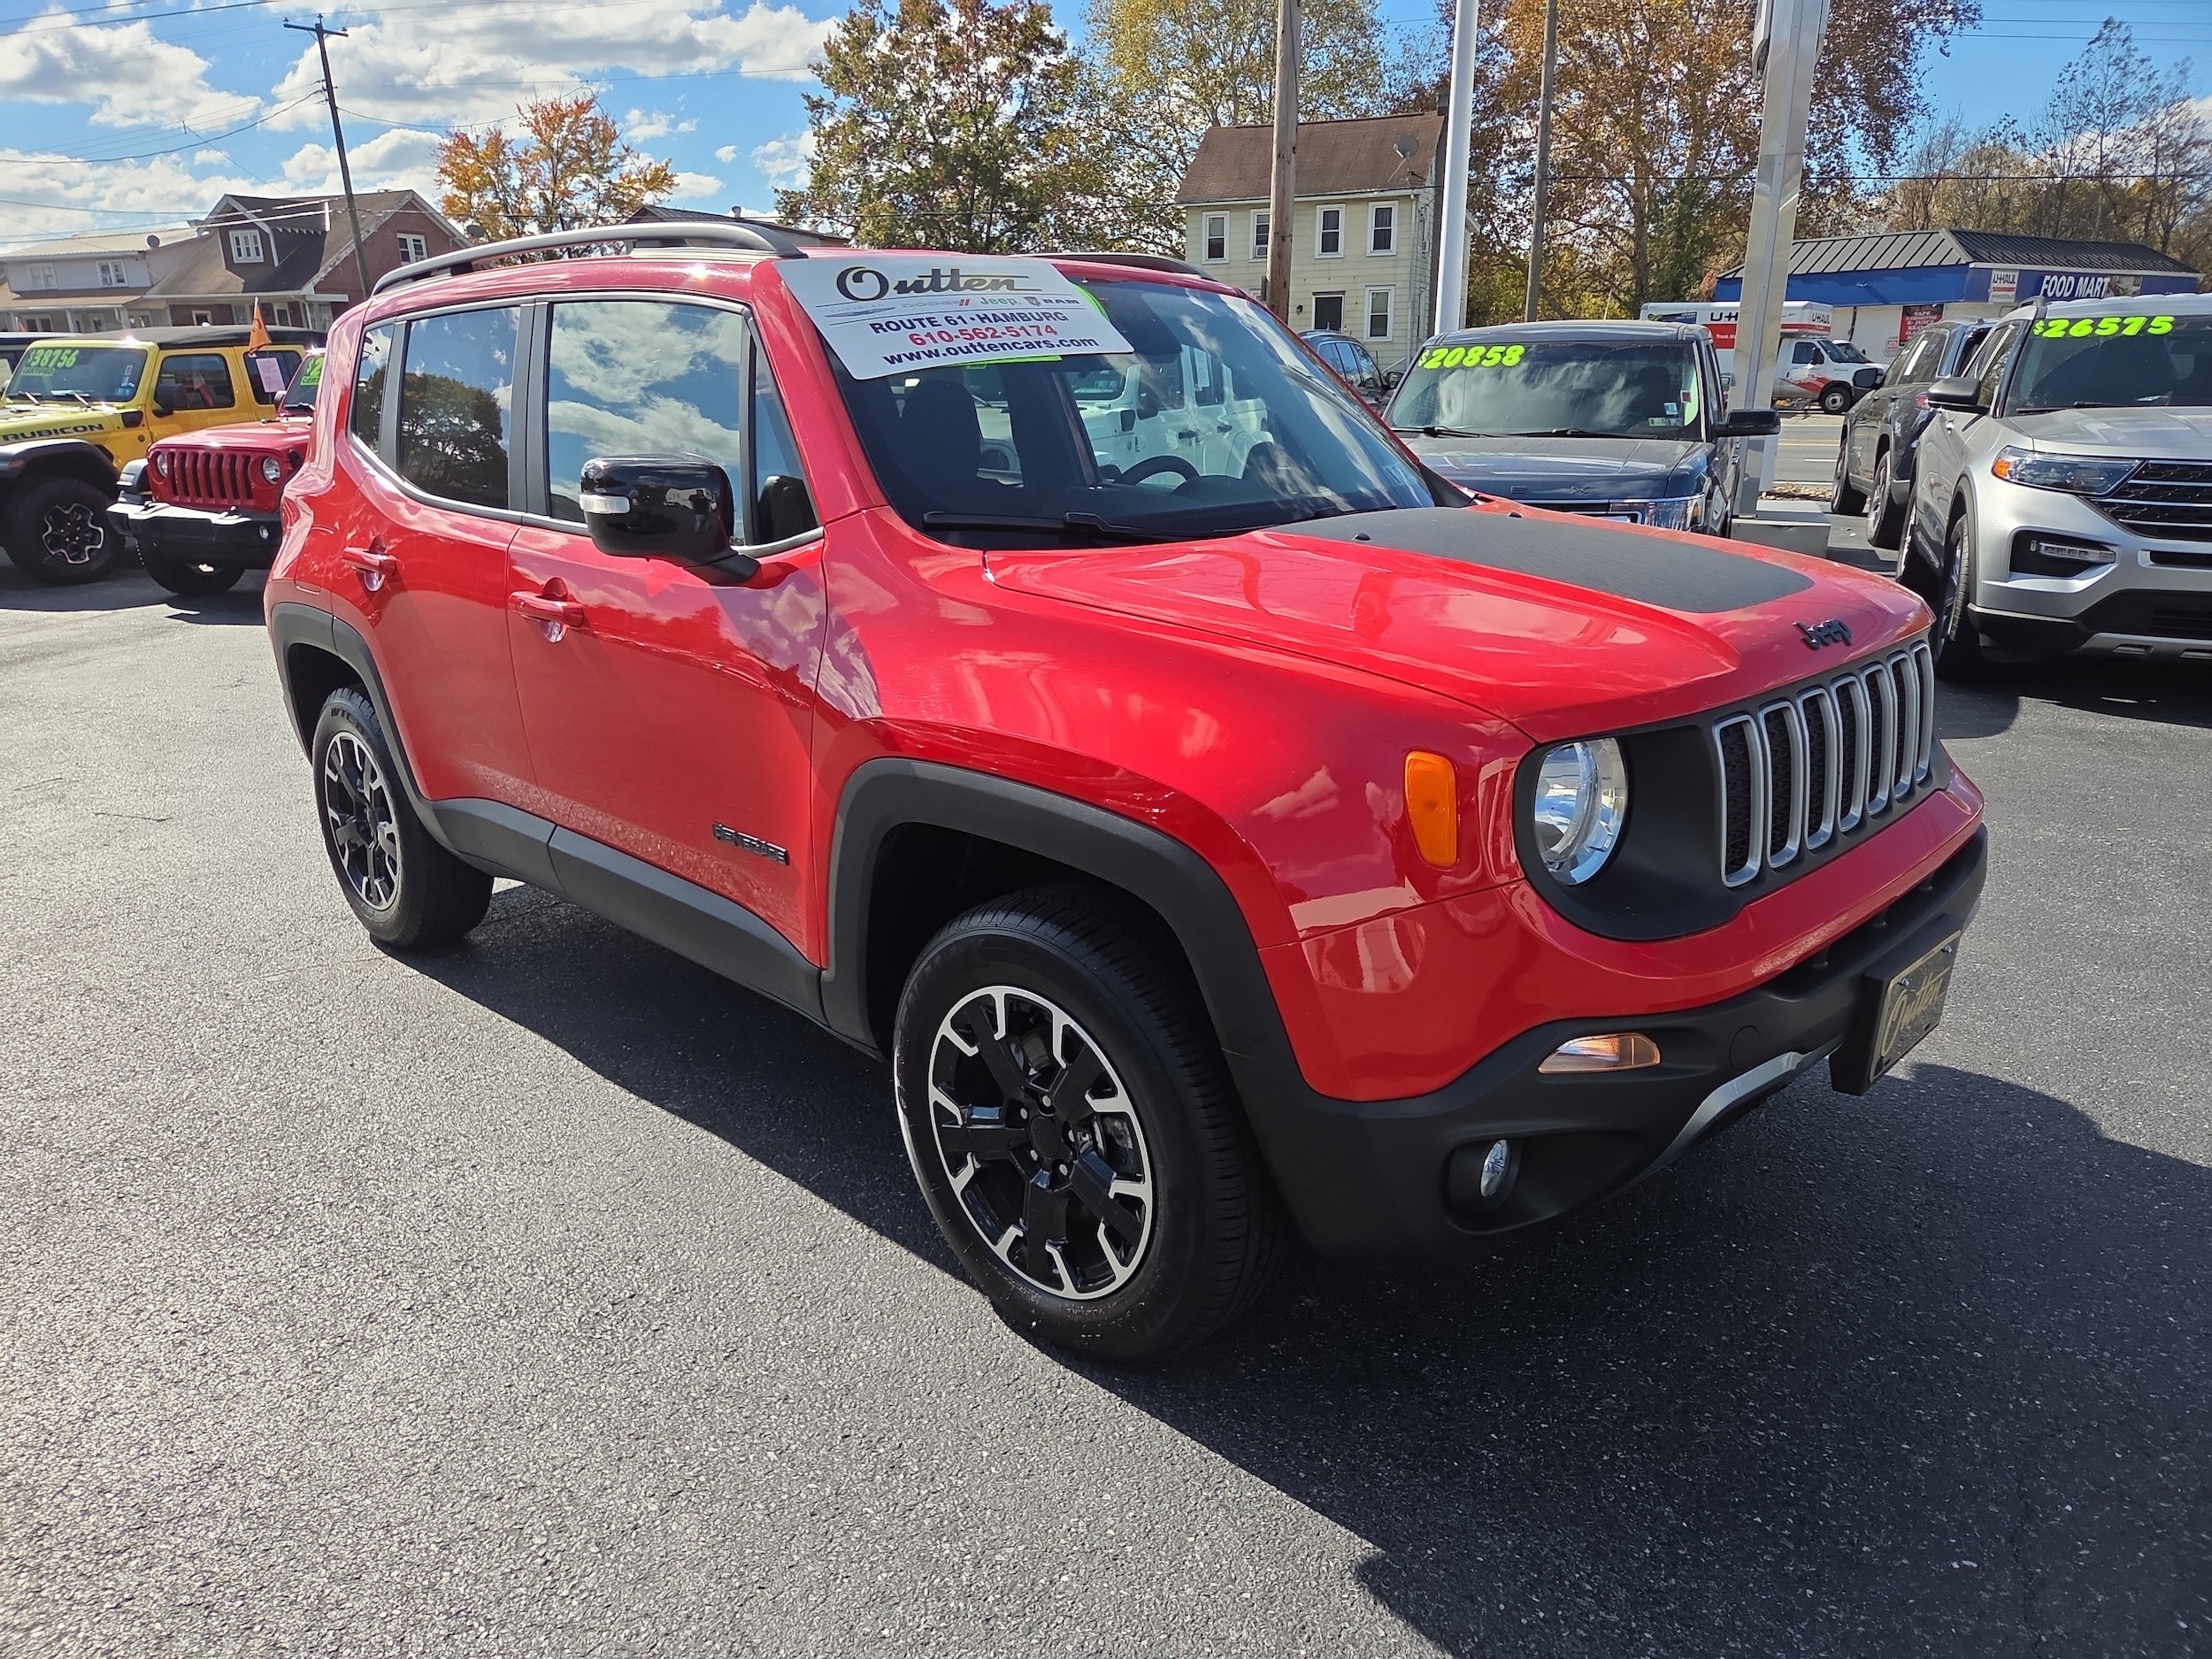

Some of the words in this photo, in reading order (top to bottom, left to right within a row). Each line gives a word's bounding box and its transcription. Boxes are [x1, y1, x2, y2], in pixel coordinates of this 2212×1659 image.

[836, 266, 1041, 301] Outten
[2040, 275, 2075, 297] FOOD
[2075, 276, 2111, 298] MART
[979, 296, 1018, 307] Jeep
[870, 316, 941, 334] ROUTE
[1709, 311, 1740, 322] U-H
[2033, 316, 2175, 338] $26575
[908, 325, 1058, 346] 610-562-5174
[28, 349, 80, 368] $38756
[882, 336, 1100, 365] www.outtencars.com
[1417, 345, 1525, 369] $20858
[2, 424, 104, 442] RUBICON
[1792, 618, 1854, 650] Jeep
[1880, 966, 1952, 1057] Outten
